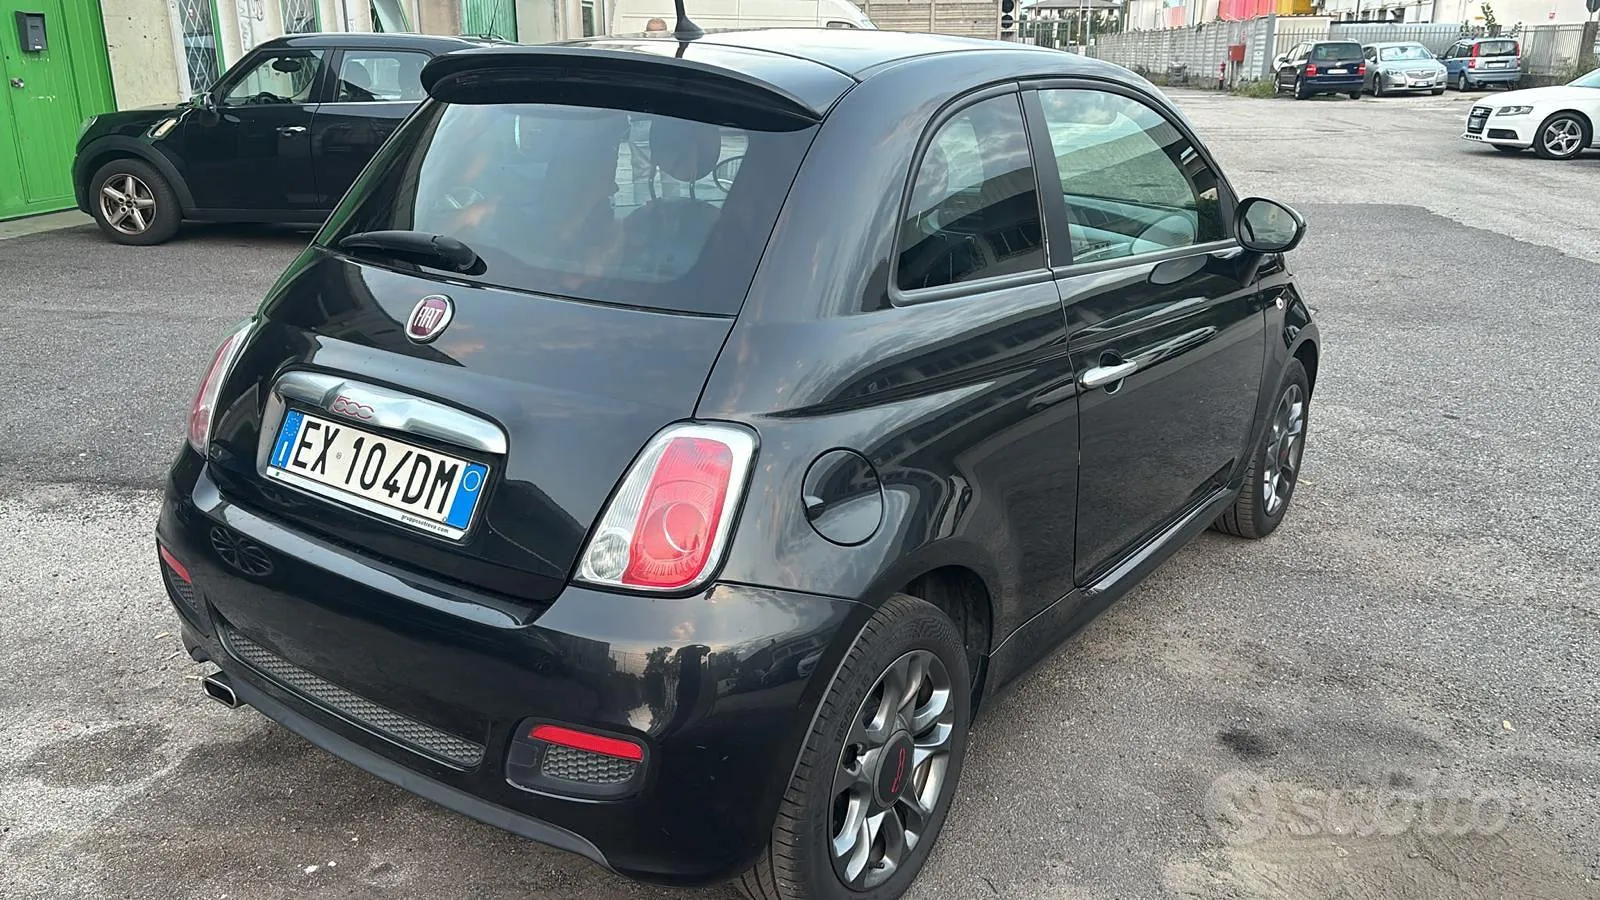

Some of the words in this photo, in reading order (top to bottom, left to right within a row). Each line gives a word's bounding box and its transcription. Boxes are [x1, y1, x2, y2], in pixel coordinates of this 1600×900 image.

[414, 302, 443, 329] FIAT
[332, 395, 375, 420] 500
[292, 421, 341, 475] EX
[345, 436, 459, 514] 104DM
